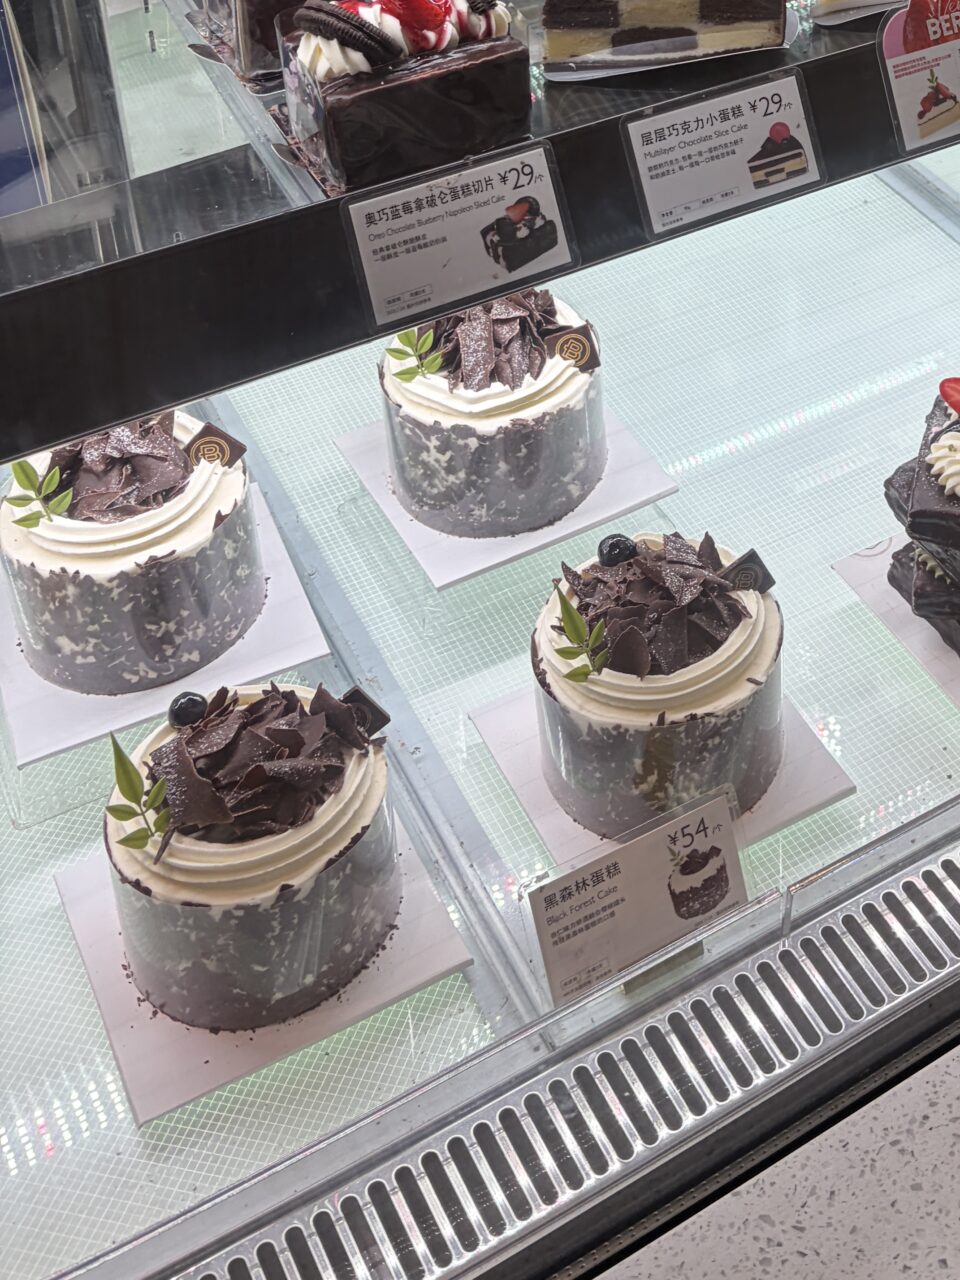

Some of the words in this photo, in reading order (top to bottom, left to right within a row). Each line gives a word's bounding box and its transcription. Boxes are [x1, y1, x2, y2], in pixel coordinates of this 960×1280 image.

[639, 103, 744, 147] 层层巧克力小蛋糕
[747, 89, 793, 120] ¥29/个
[643, 143, 676, 161] Multilayer
[677, 132, 713, 150] Chocolate
[713, 127, 729, 138] Slice
[730, 121, 748, 133] Cake
[497, 159, 544, 193] ¥29/个
[363, 174, 495, 228] 奥巧蓝莓拿破仑蛋糕切片
[542, 859, 621, 912] 黑森林蛋糕
[546, 908, 568, 926] Black
[569, 894, 595, 915] Forest
[596, 882, 618, 901] Cake
